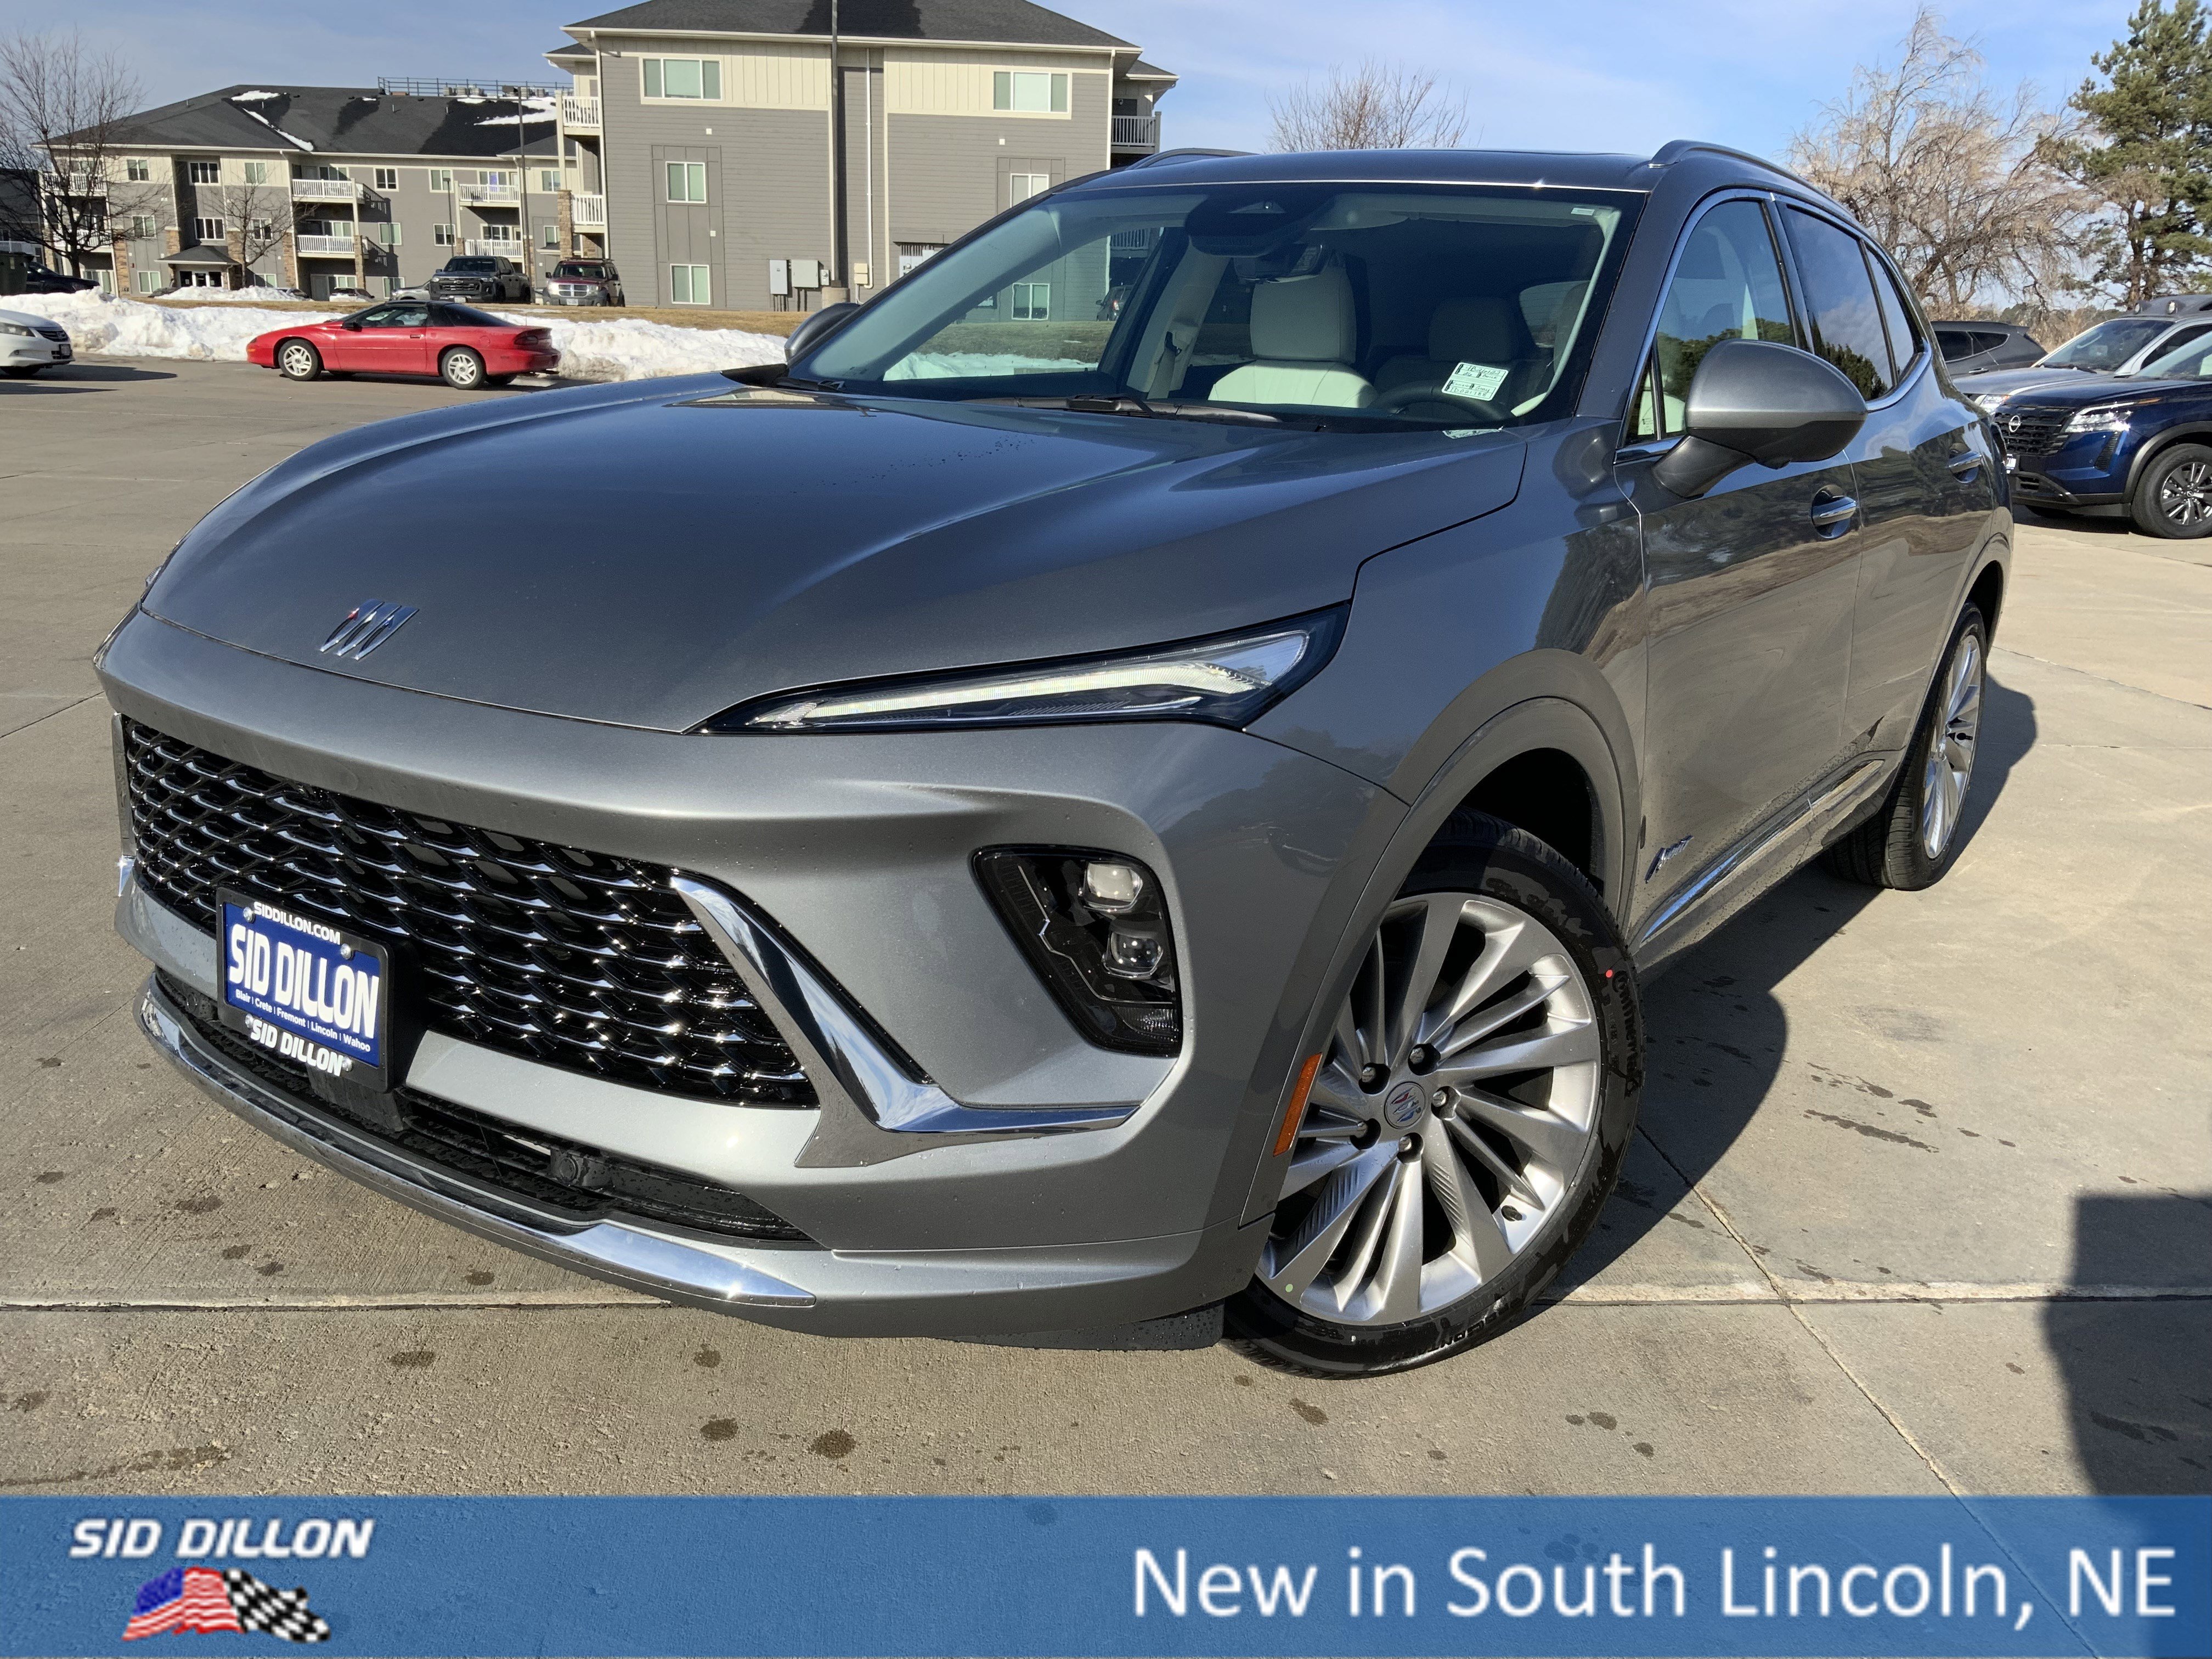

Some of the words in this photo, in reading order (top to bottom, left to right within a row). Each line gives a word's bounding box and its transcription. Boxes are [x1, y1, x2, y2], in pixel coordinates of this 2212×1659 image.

[253, 901, 341, 945] SIDDILLON.COM
[229, 923, 270, 996] SID
[274, 941, 380, 1039] DILLON
[235, 989, 251, 1003] Blair
[255, 997, 273, 1013] Crete
[276, 1007, 306, 1028] Fremont
[311, 1021, 338, 1040] Lincoln
[343, 1033, 371, 1052] Wahoo
[250, 1018, 278, 1049] SID
[280, 1031, 344, 1077] DILLON
